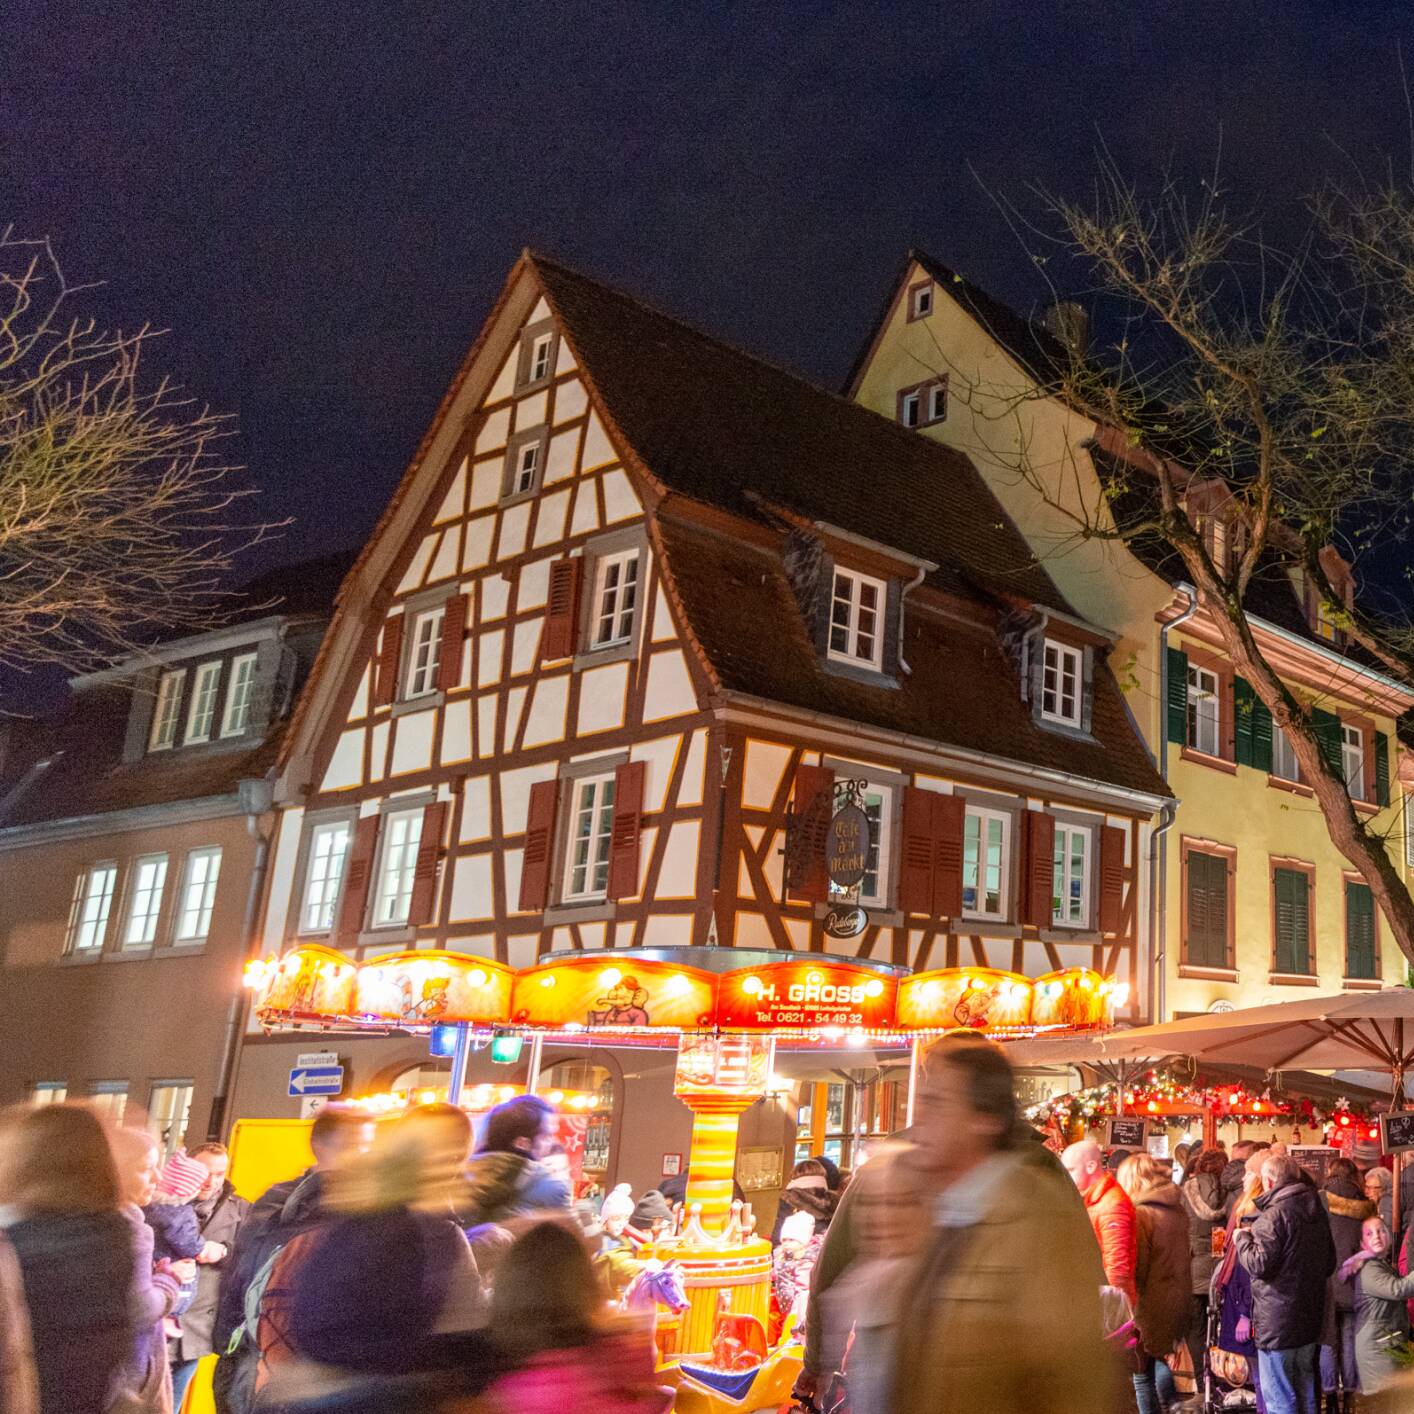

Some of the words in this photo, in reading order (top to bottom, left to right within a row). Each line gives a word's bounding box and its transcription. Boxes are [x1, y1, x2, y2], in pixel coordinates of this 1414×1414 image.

[831, 853, 865, 872] Markt
[788, 984, 865, 1003] GROSS
[756, 1011, 773, 1022] Tel.
[776, 1012, 805, 1023] 0621
[815, 1013, 830, 1023] 54
[832, 1013, 847, 1023] 49
[848, 1014, 863, 1024] 32
